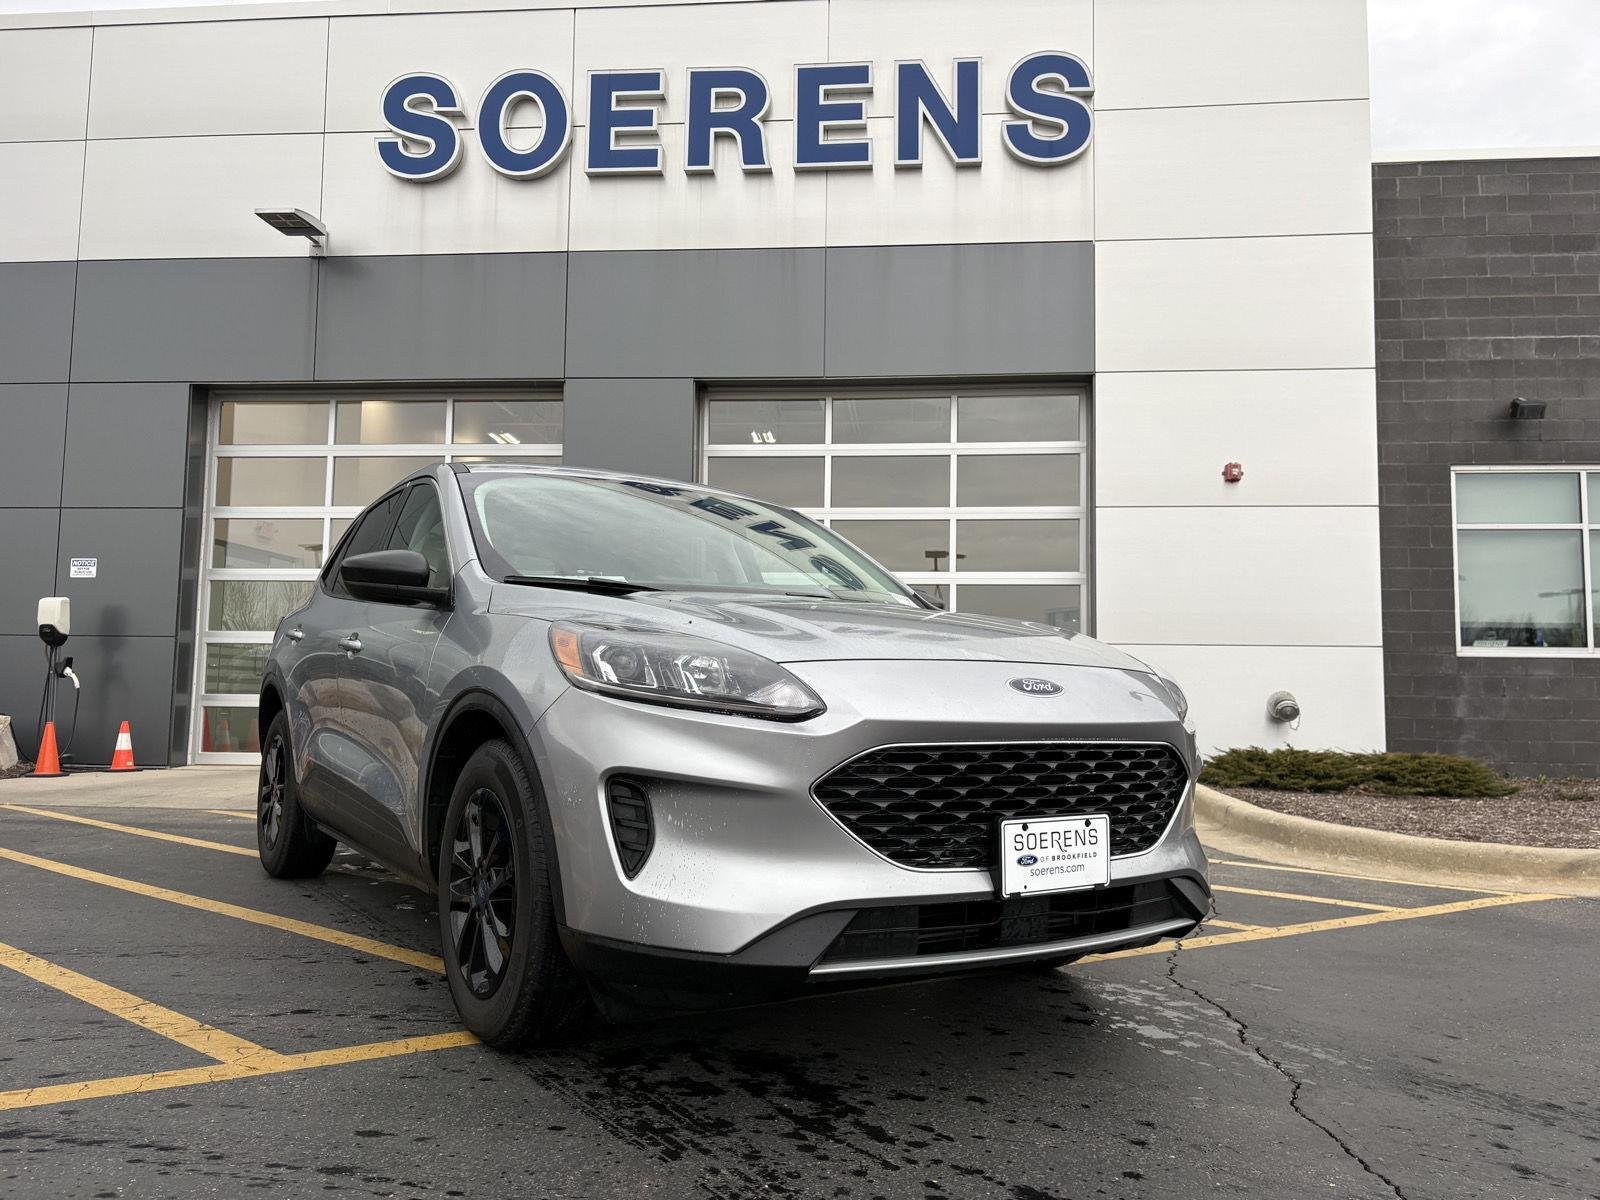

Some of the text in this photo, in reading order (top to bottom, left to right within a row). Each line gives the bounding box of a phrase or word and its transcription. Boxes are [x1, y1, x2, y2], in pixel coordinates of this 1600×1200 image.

[375, 51, 1095, 182] SOERENS
[1022, 679, 1053, 691] Ford
[1014, 829, 1098, 852] SOERENS
[1051, 852, 1098, 861] BROOKFIELD
[1030, 863, 1085, 877] soerens.com
